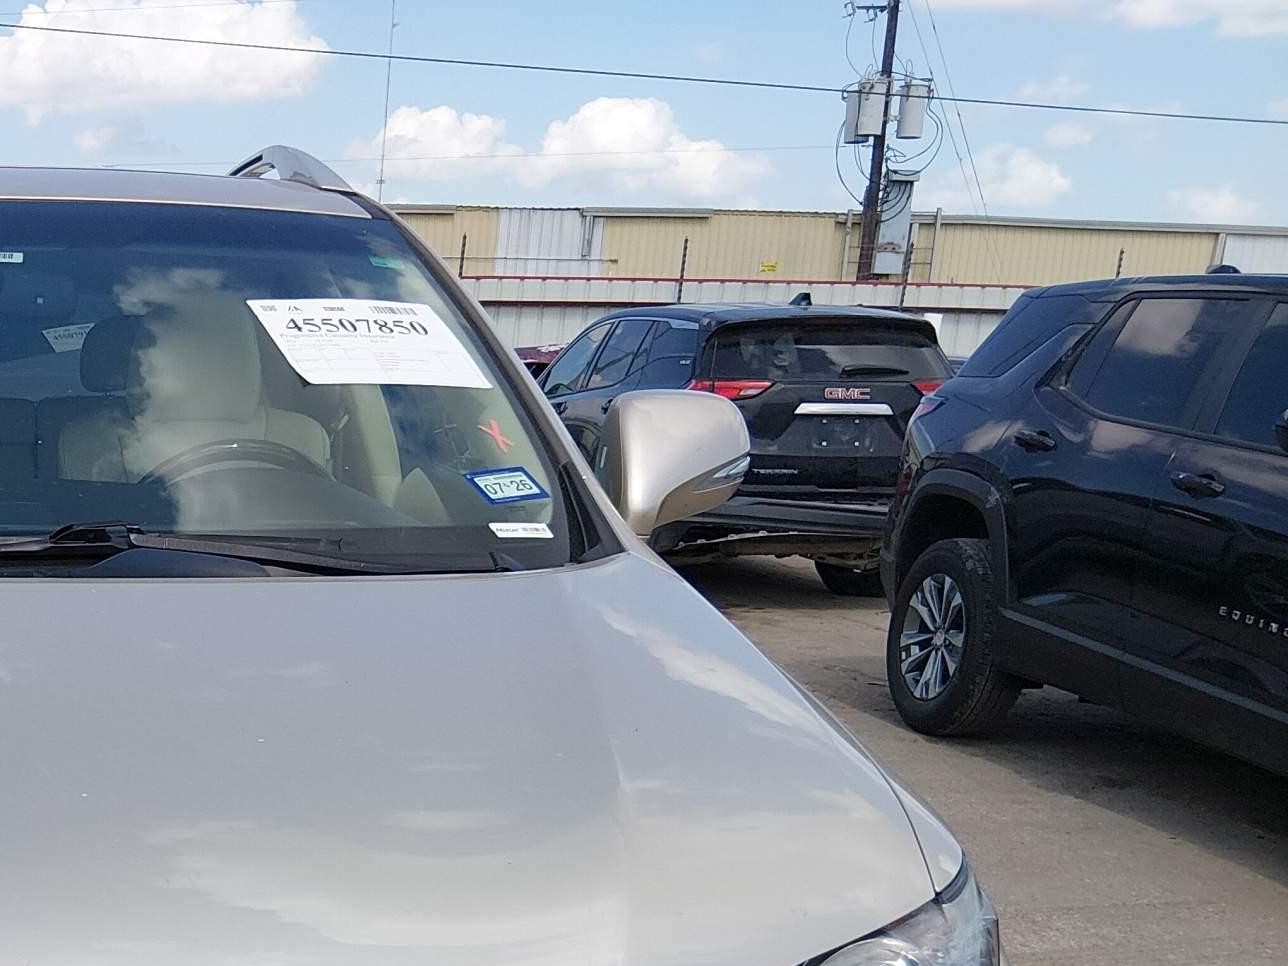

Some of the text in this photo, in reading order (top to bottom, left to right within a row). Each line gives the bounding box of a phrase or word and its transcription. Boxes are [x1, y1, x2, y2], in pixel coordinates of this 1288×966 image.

[285, 317, 429, 336] 45507850
[824, 387, 871, 400] GMC
[484, 479, 534, 495] 07 26
